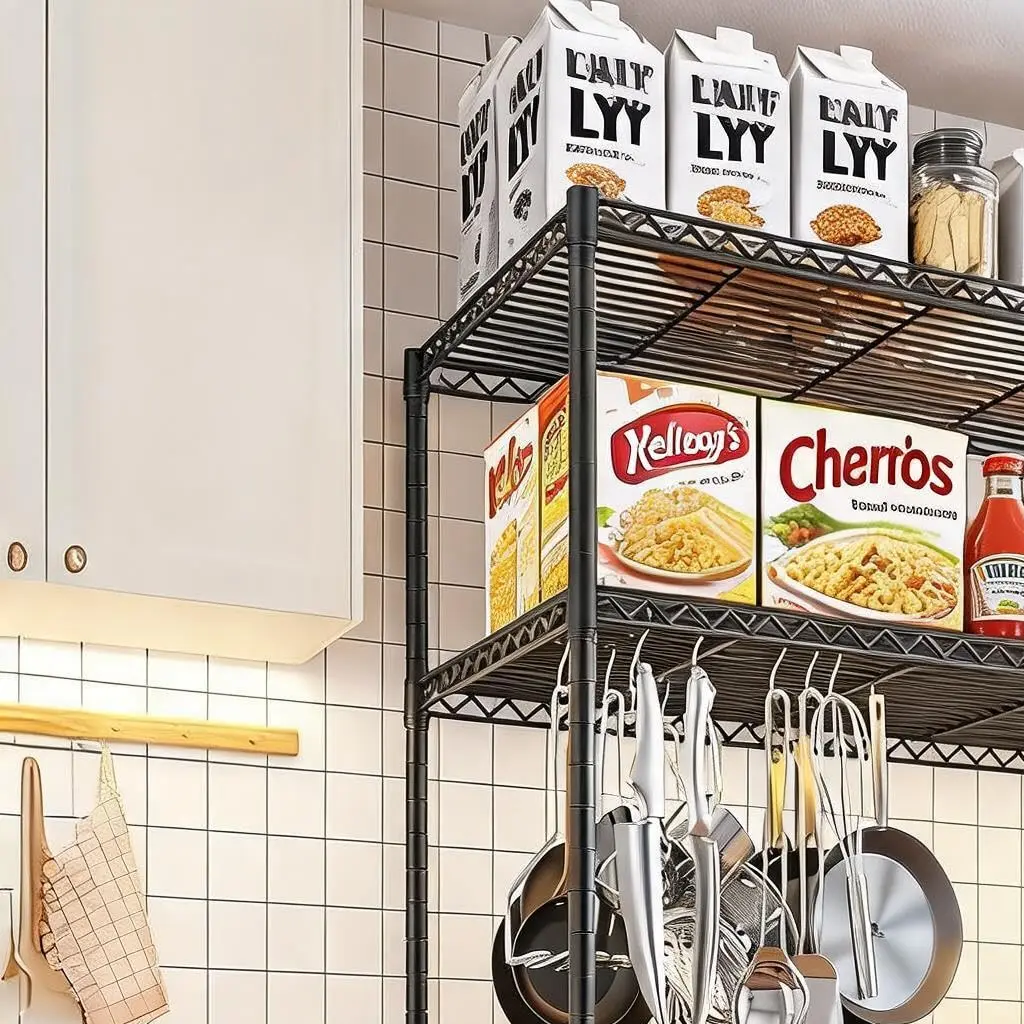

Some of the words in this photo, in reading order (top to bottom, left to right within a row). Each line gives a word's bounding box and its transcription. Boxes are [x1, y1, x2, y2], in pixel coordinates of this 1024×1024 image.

[569, 86, 651, 146] LYY
[695, 111, 776, 164] LYY
[822, 129, 898, 181] LYY
